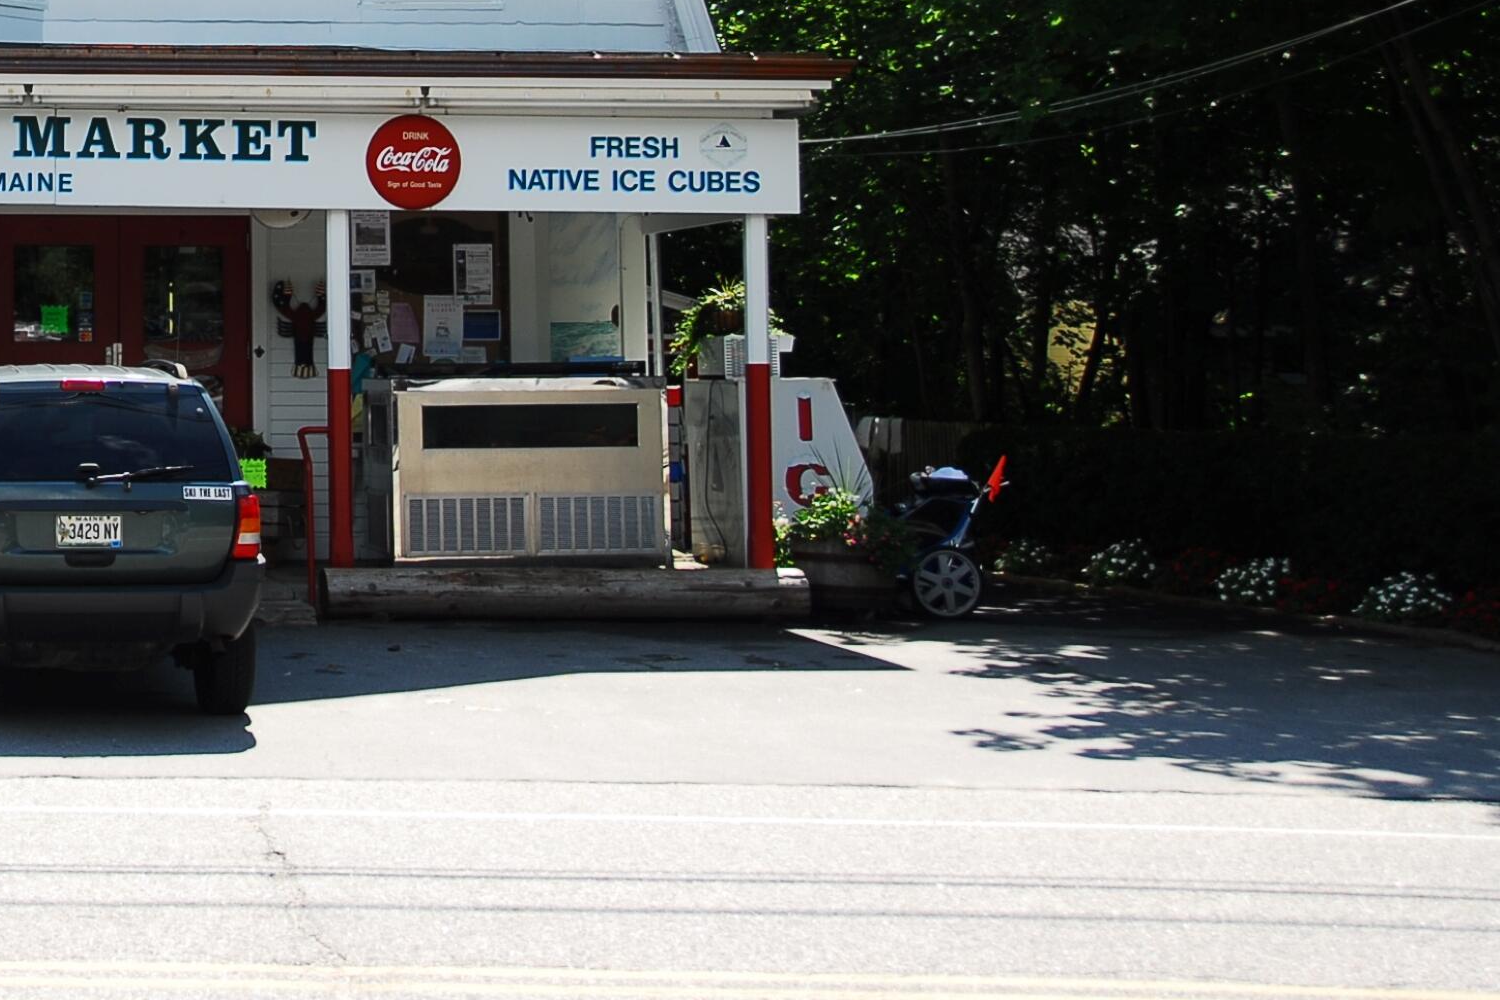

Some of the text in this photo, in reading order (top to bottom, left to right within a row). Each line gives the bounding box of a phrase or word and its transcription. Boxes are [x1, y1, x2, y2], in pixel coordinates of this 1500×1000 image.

[12, 115, 318, 163] MARKET
[402, 130, 430, 141] DRINK
[590, 136, 679, 159] FRESH
[376, 145, 453, 174] Coca-Cola
[508, 168, 761, 194] NATIVE ICE CUBES
[184, 487, 197, 498] SKI
[199, 487, 211, 498] THE
[68, 522, 119, 540] 3429 NY
